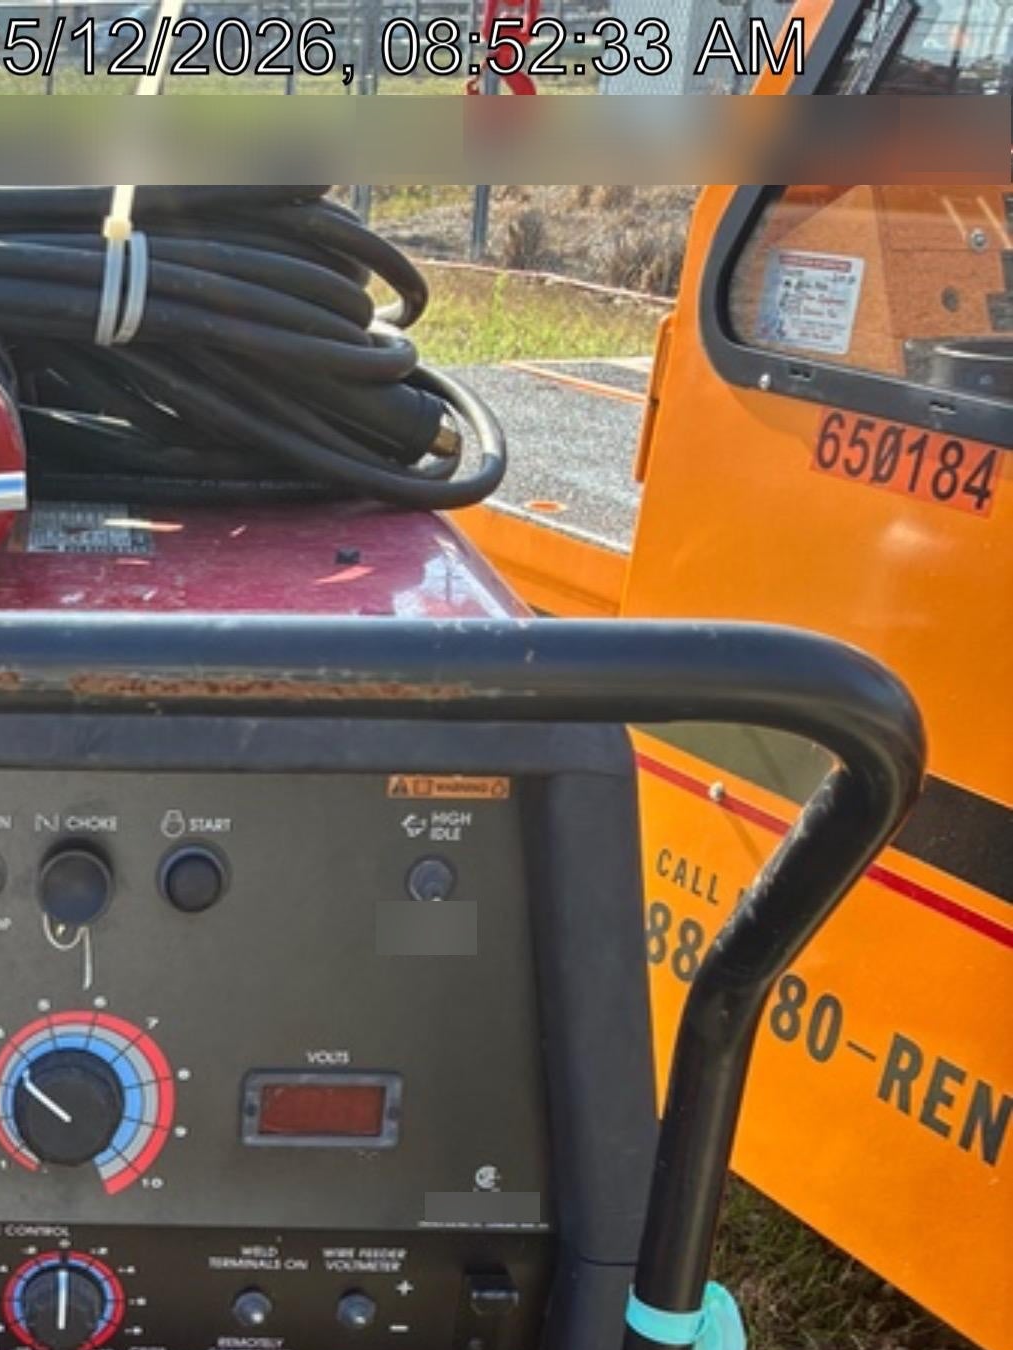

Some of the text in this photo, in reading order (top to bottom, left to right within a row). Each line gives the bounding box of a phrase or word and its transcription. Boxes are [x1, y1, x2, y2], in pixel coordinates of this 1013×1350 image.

[816, 411, 997, 511] 650184
[67, 816, 117, 832] CHOKE
[189, 818, 231, 832] START
[431, 811, 472, 825] HIGH
[430, 826, 462, 840] IDLE
[656, 848, 719, 906] CALL
[306, 1049, 350, 1064] VOLTS
[141, 1177, 163, 1189] 10
[4, 1225, 70, 1236] CONTROL
[241, 1246, 279, 1257] WELD
[323, 1248, 407, 1259] WIRE FEEDER
[208, 1257, 308, 1270] TERMINALS ON
[325, 1260, 402, 1271] VOLTMETER
